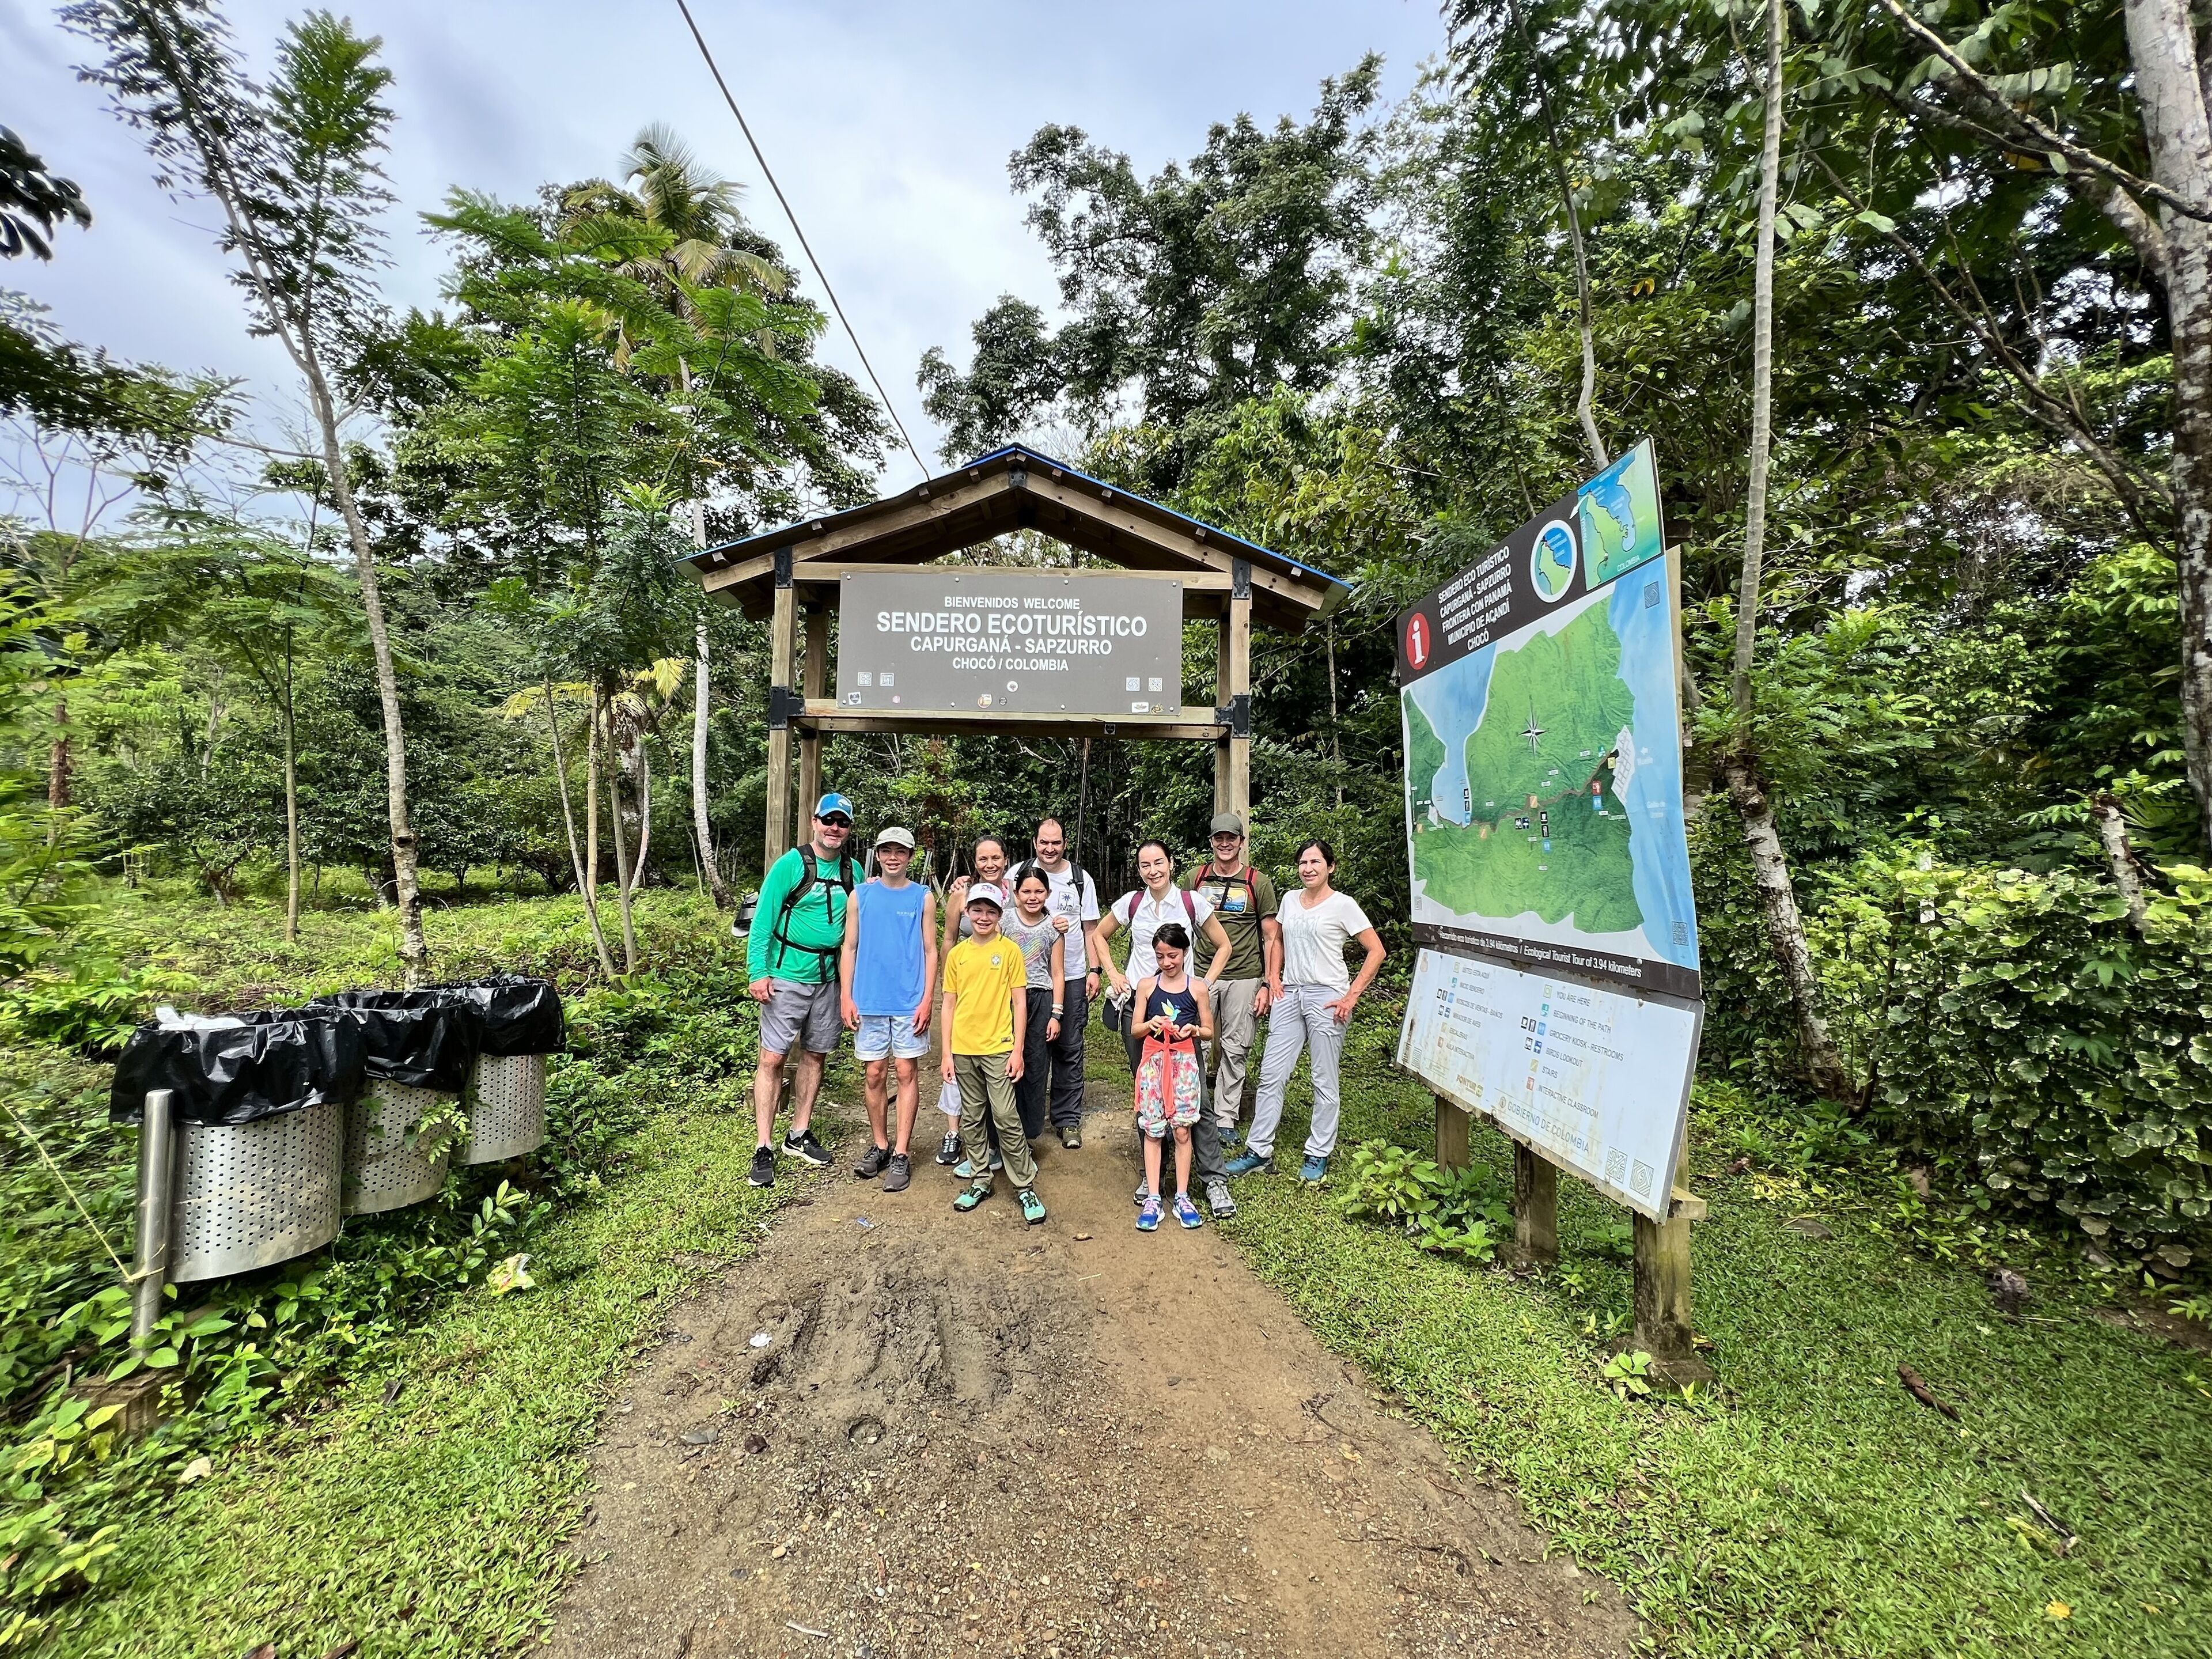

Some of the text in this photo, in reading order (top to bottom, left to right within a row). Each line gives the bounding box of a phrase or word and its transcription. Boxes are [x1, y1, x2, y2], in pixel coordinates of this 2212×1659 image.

[1438, 546, 1509, 604] SENDERO ECO TURÍSTICO
[945, 596, 1080, 610] BIENVENIDOS WELCOME
[1440, 588, 1474, 619] CAPURGANÁ
[1476, 563, 1511, 595] SAPZURRO
[1442, 578, 1513, 633] FRONTERA CON PANAMÁ
[876, 611, 1147, 637] SENDERO ECOTURÍSTICO
[1448, 620, 1476, 645] MUNICIPIO
[1476, 615, 1485, 630] DE
[911, 634, 1010, 653] CAPURGANÁ
[1025, 638, 1112, 655] SAPZURRO
[1467, 628, 1490, 651] CHOCÓ
[952, 655, 1069, 671] CHOCÓ / COLOMBIA
[1486, 938, 1495, 948] 3.94
[1524, 945, 1551, 960] Ecological
[1551, 950, 1571, 964] Tourist
[1571, 953, 1585, 966] Tour
[1585, 957, 1593, 967] of
[1593, 957, 1607, 970] 3.94
[1608, 961, 1642, 978] kilometers
[1556, 991, 1590, 1007] YOU ARE HERE
[1553, 1009, 1611, 1034] BEGINNING OF THE PATH
[1546, 1047, 1584, 1067] BIRDS LOOKOUT
[1549, 1029, 1571, 1043] GROCERY
[1571, 1036, 1587, 1048] KIOSK
[1590, 1043, 1624, 1061] RESTROOMS
[1541, 1066, 1558, 1078] STAIRS
[1538, 1085, 1599, 1119] INTERACTIVE CLASSROOM
[1508, 1101, 1590, 1153] GOBIERNO DE COLOMBIA
